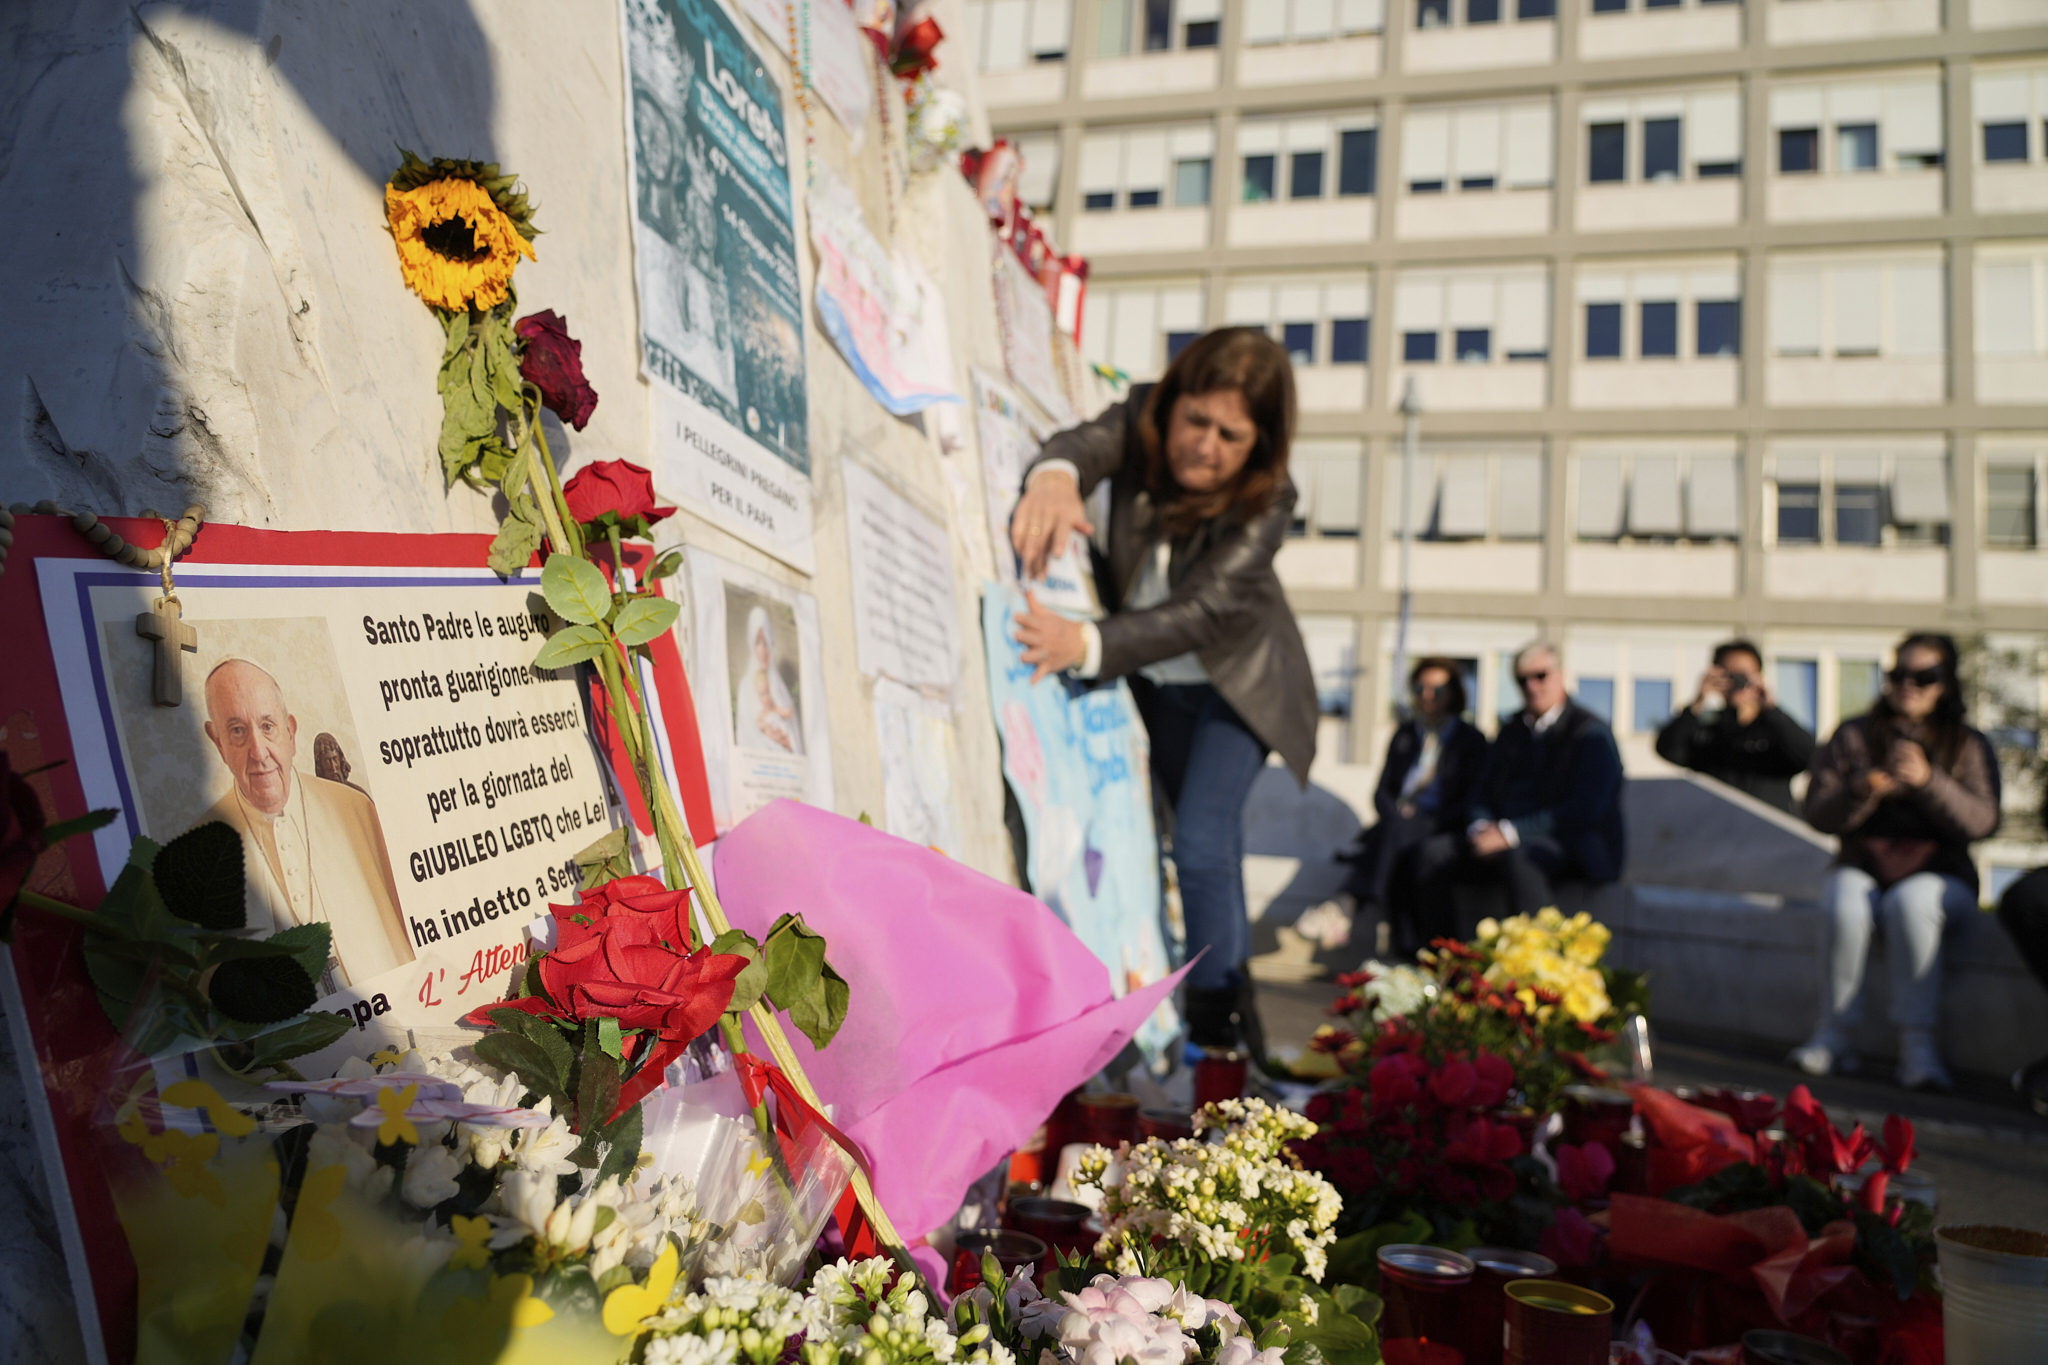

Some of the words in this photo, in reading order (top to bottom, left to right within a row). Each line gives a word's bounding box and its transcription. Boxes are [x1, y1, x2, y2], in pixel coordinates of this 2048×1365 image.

[704, 37, 786, 167] Loreto
[684, 426, 748, 480] PELLEGRINI
[711, 482, 732, 507] PER
[734, 495, 744, 514] IL
[748, 502, 776, 531] PAPA
[363, 615, 421, 645] Santo
[422, 611, 474, 641] Padre
[475, 611, 493, 637] le
[497, 611, 549, 641] auguro
[379, 670, 443, 711] pronta
[379, 720, 482, 768] soprattutto
[484, 711, 530, 744] dovrà
[530, 703, 580, 734] esserci
[427, 786, 458, 823] per
[459, 778, 480, 807] la
[481, 763, 548, 809] giornata
[549, 754, 574, 783] del
[409, 830, 499, 883] GIUBILEO
[500, 813, 556, 853] LGBTQ
[556, 807, 582, 834] che
[583, 796, 606, 826] Lei
[409, 914, 441, 948] ha
[440, 887, 531, 938] indetto
[535, 876, 549, 898] a
[547, 859, 585, 892] Sette
[322, 992, 392, 1032] pa
